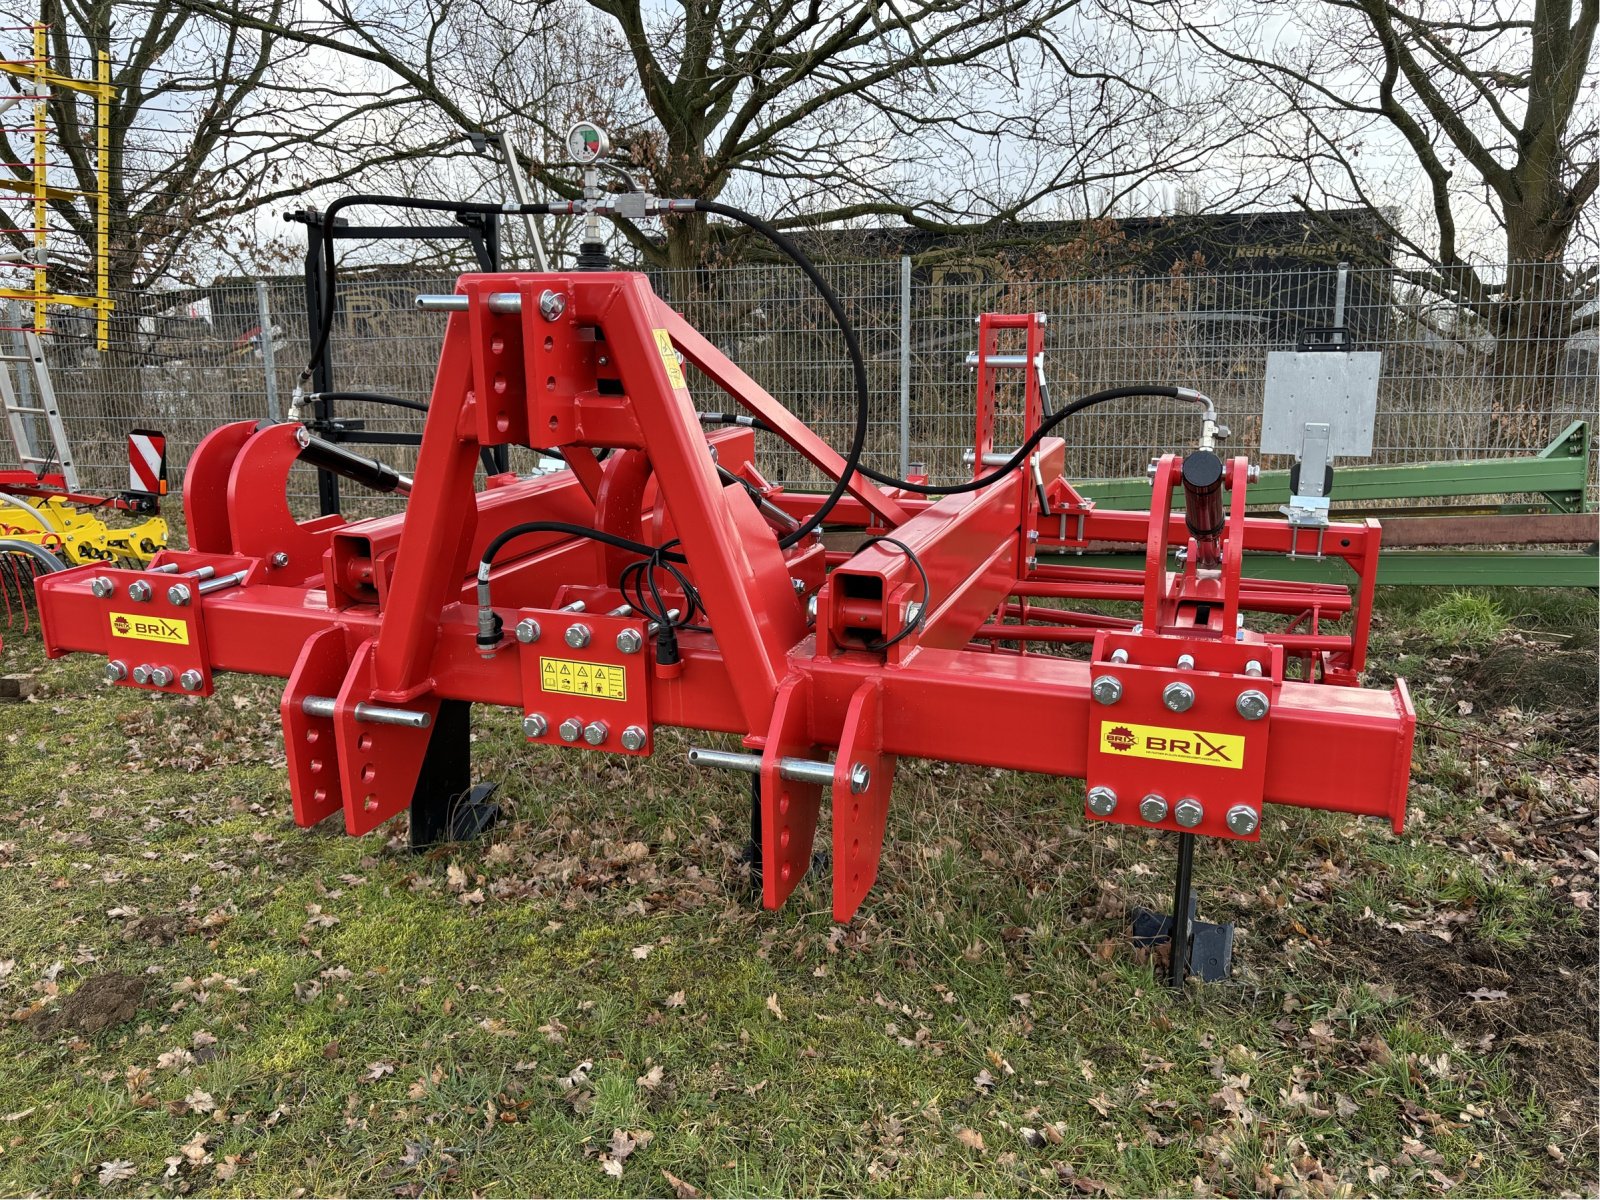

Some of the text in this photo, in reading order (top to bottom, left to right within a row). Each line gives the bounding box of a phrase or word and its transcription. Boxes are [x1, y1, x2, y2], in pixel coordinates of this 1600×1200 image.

[135, 619, 183, 639] BRIX
[1106, 734, 1137, 745] BRIX
[1146, 732, 1232, 761] BRIX
